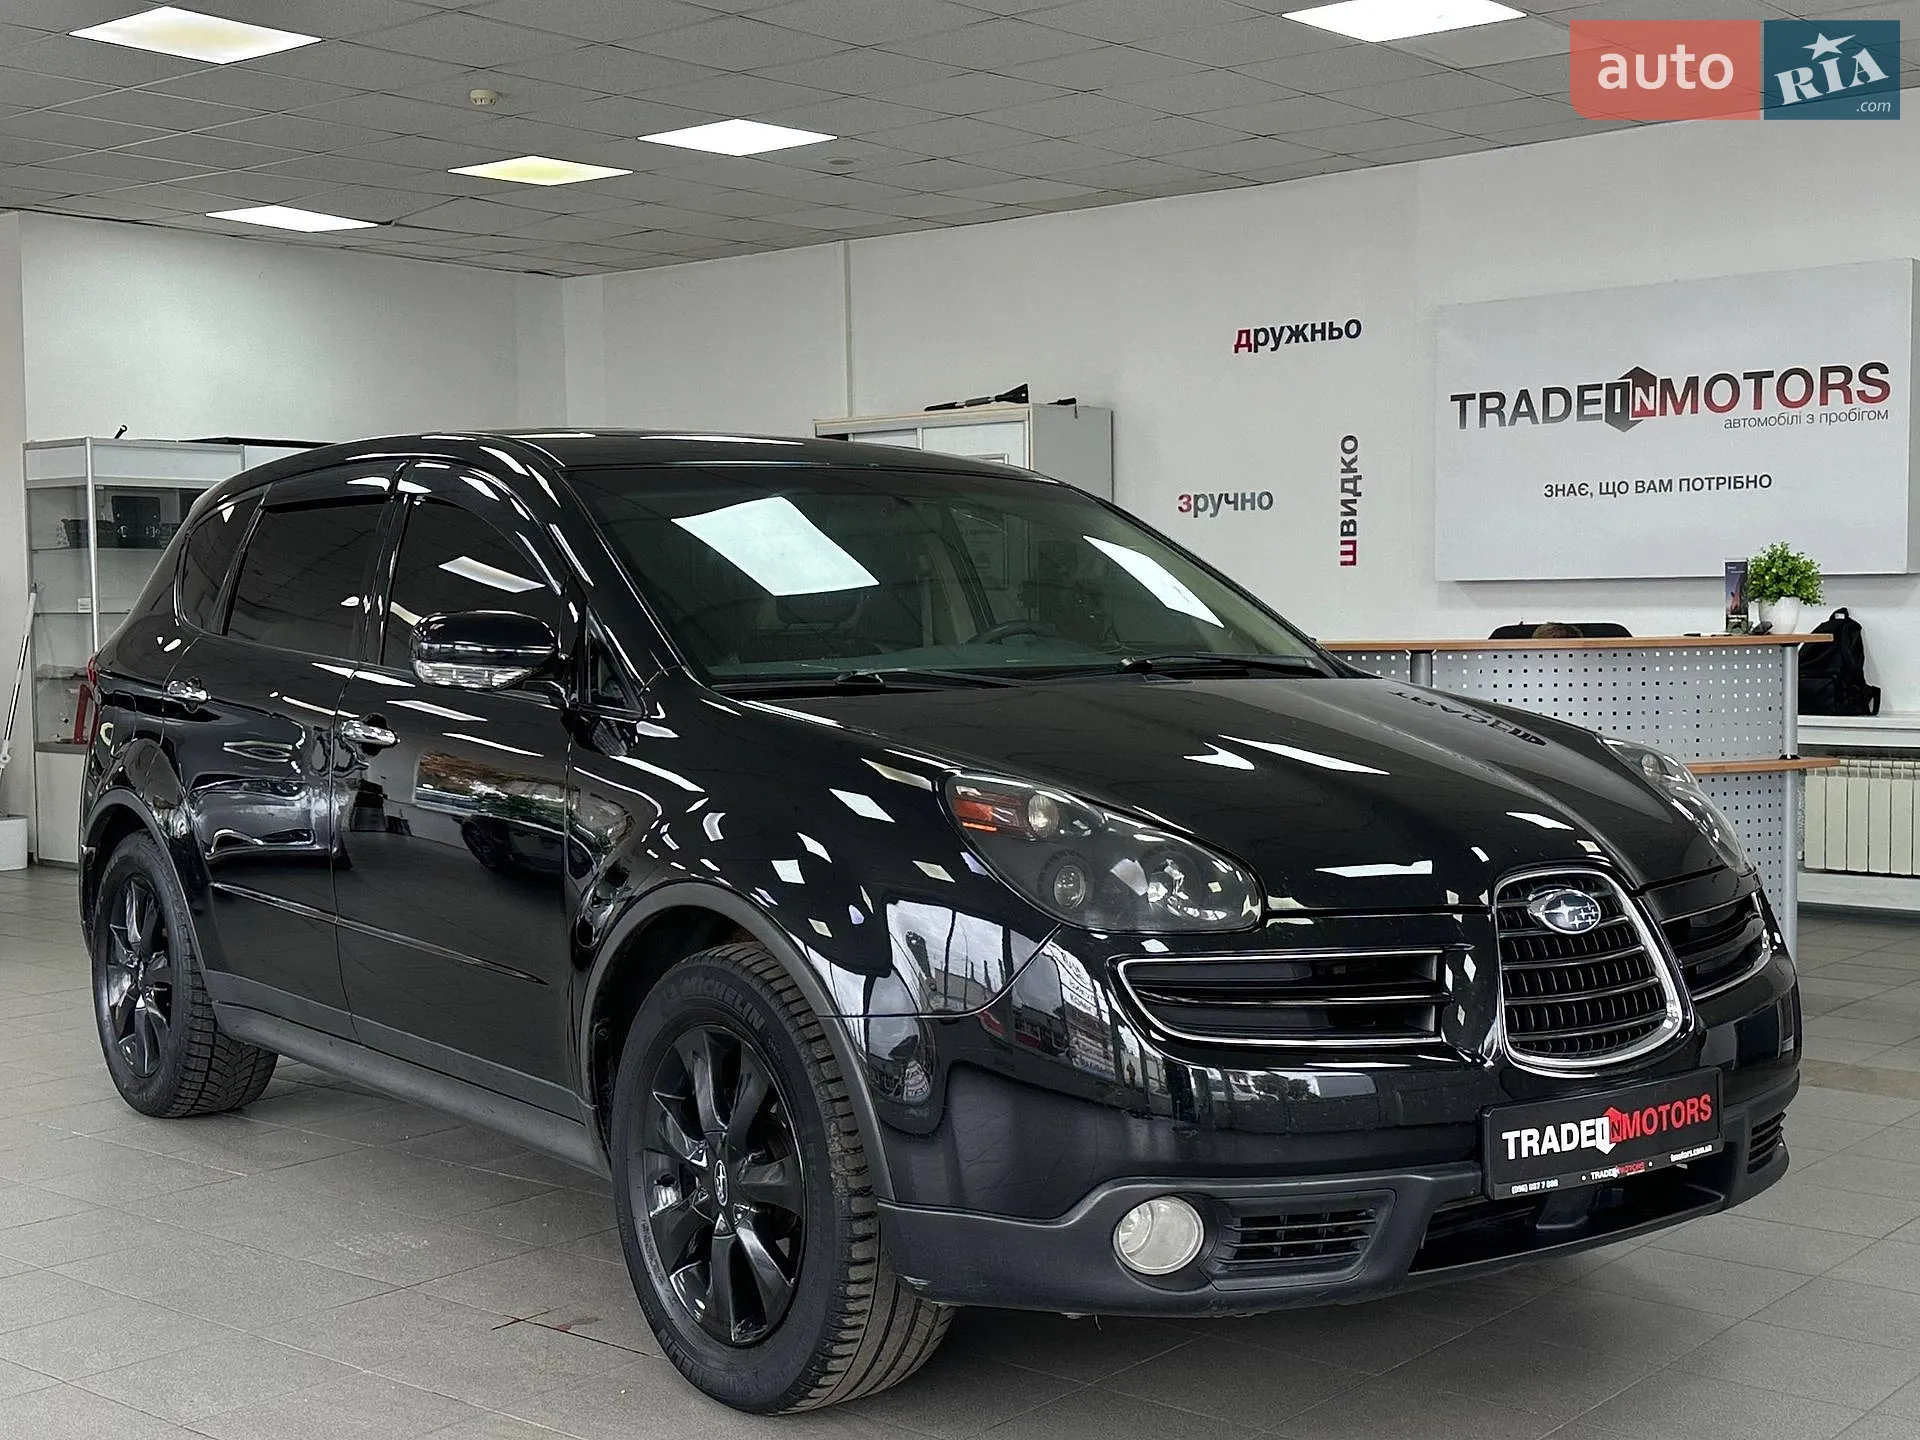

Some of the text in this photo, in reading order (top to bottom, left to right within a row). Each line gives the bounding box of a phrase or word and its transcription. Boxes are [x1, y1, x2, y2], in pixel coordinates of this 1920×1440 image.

[1233, 318, 1362, 354] дружньо
[1724, 407, 1889, 429] автомобілі з пробігом
[1340, 434, 1362, 567] швидко
[1543, 474, 1773, 499] ЗНАЄ, ЩО ВАМ ПОТРІБНО
[1177, 490, 1274, 518] зручно
[681, 975, 768, 1032] MICHELIN
